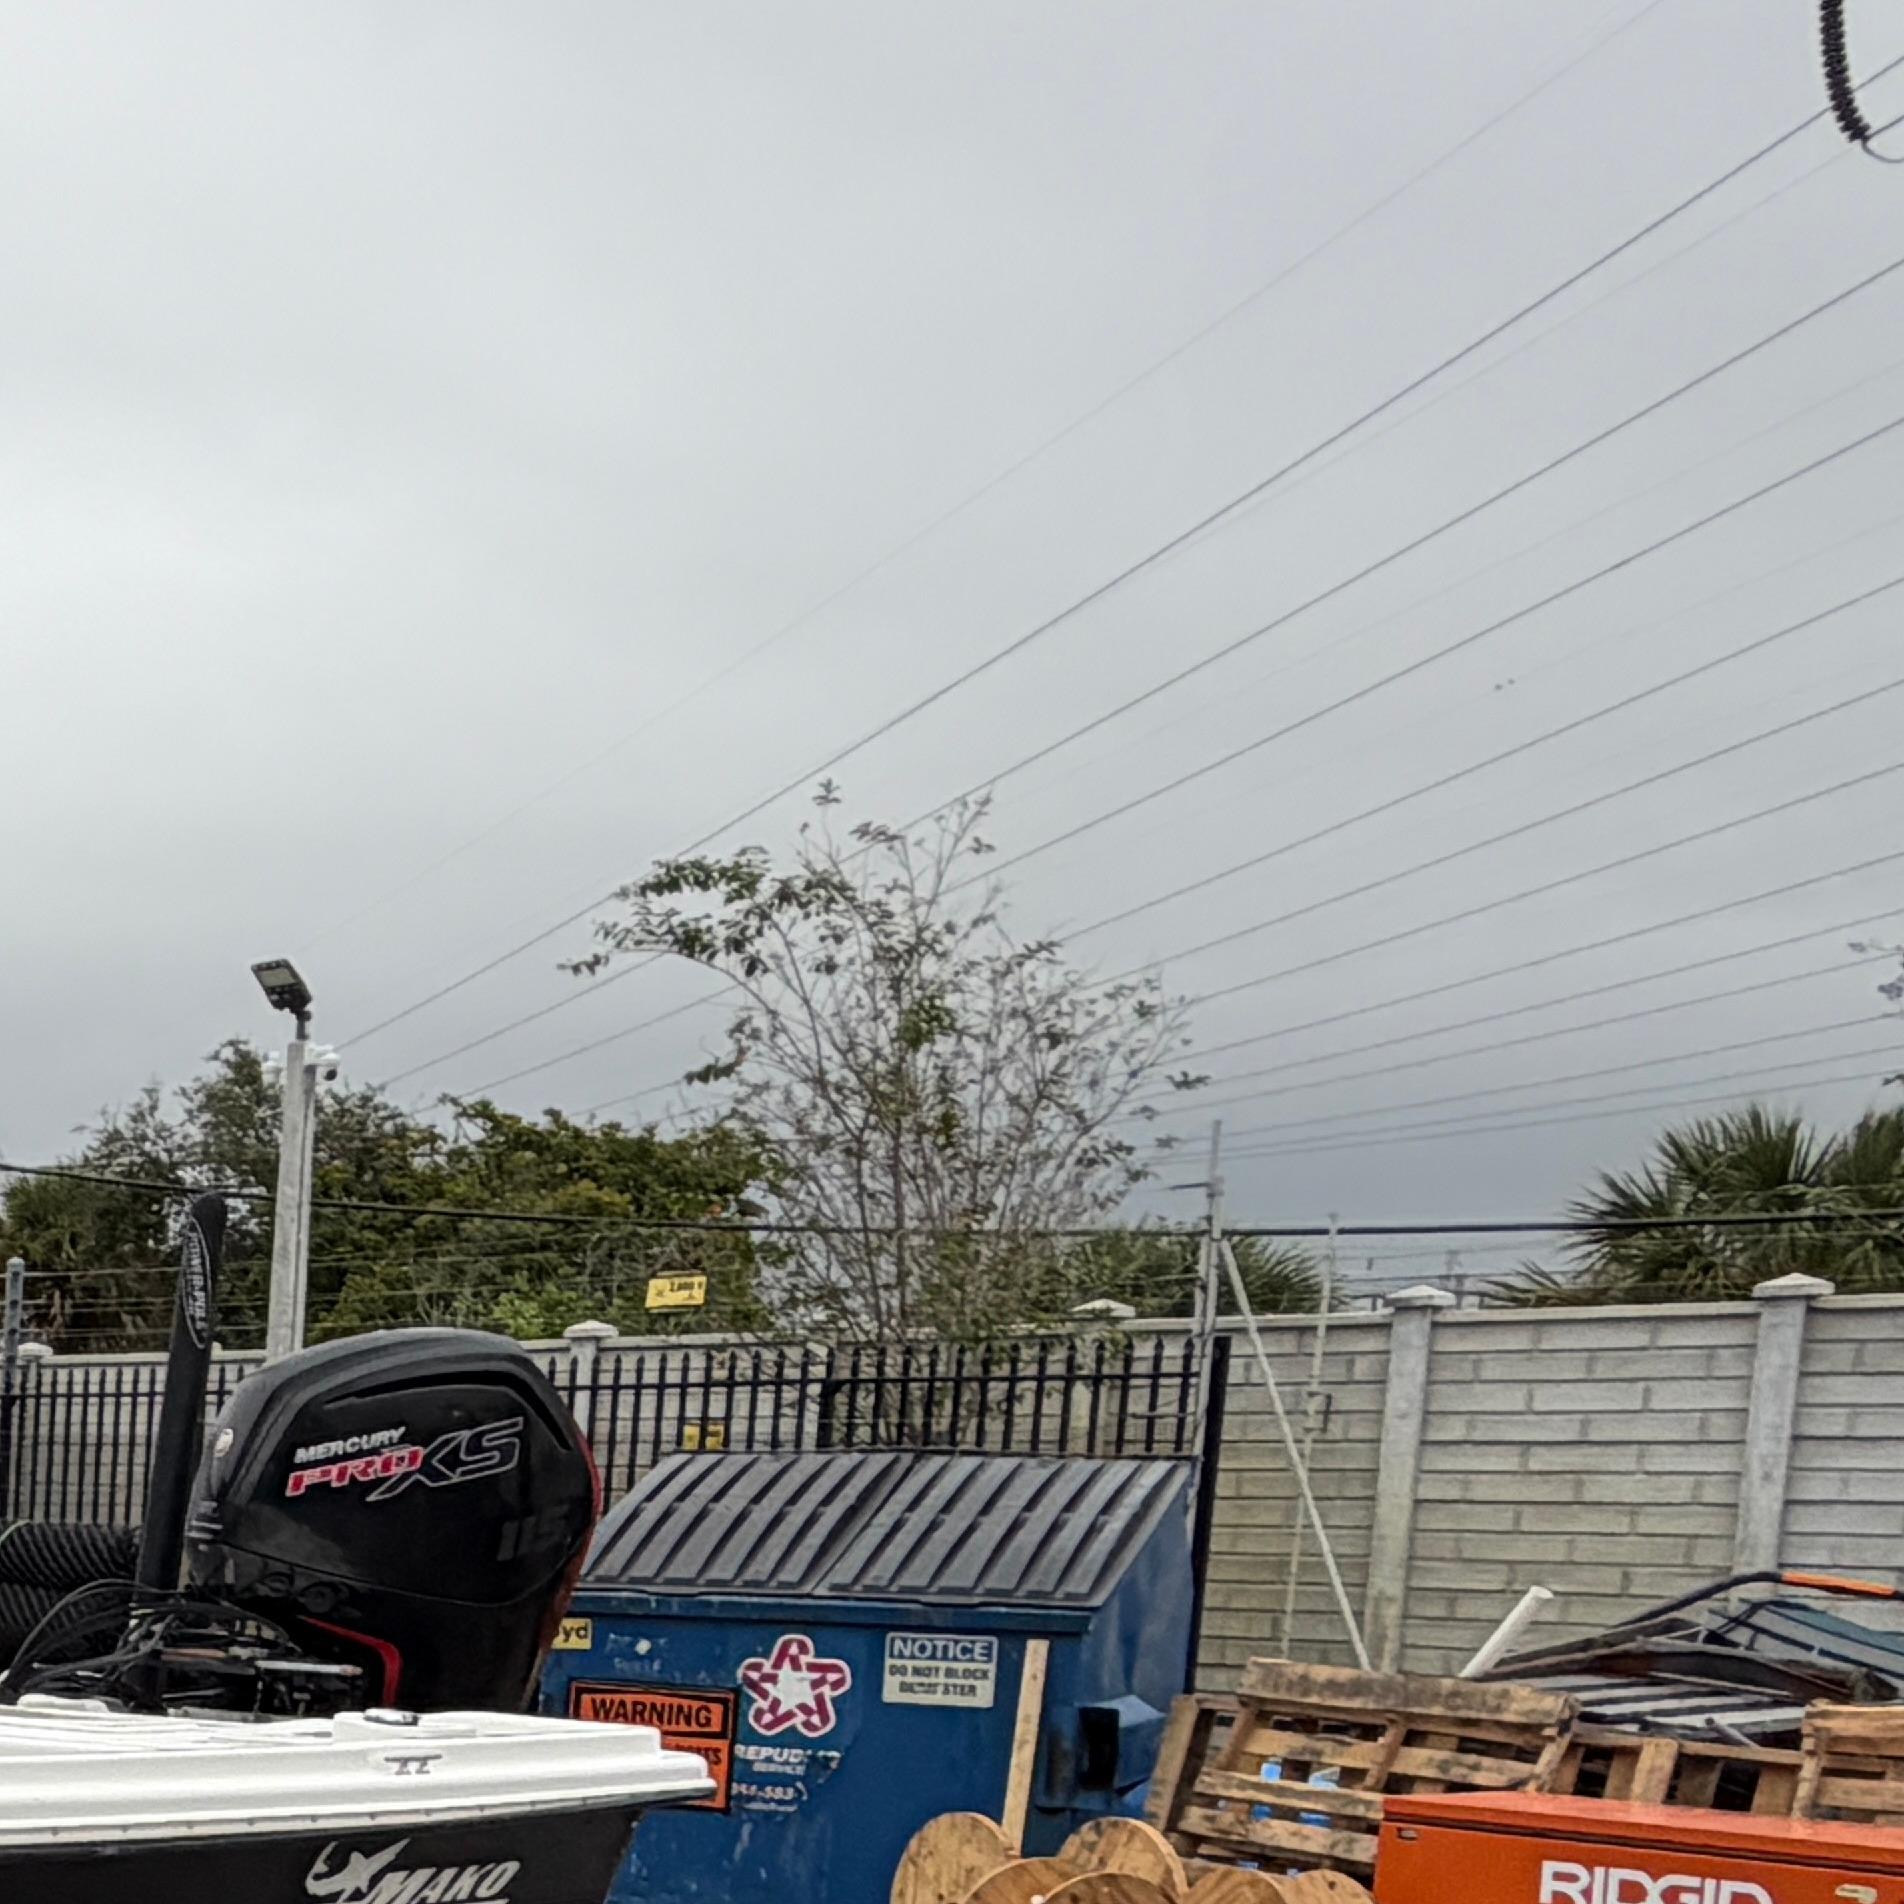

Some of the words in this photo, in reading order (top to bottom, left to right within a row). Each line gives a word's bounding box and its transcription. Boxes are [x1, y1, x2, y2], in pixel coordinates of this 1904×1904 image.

[294, 1426, 407, 1463] MERCURY
[893, 1637, 989, 1661] NOTICE
[591, 1696, 712, 1728] WARNING
